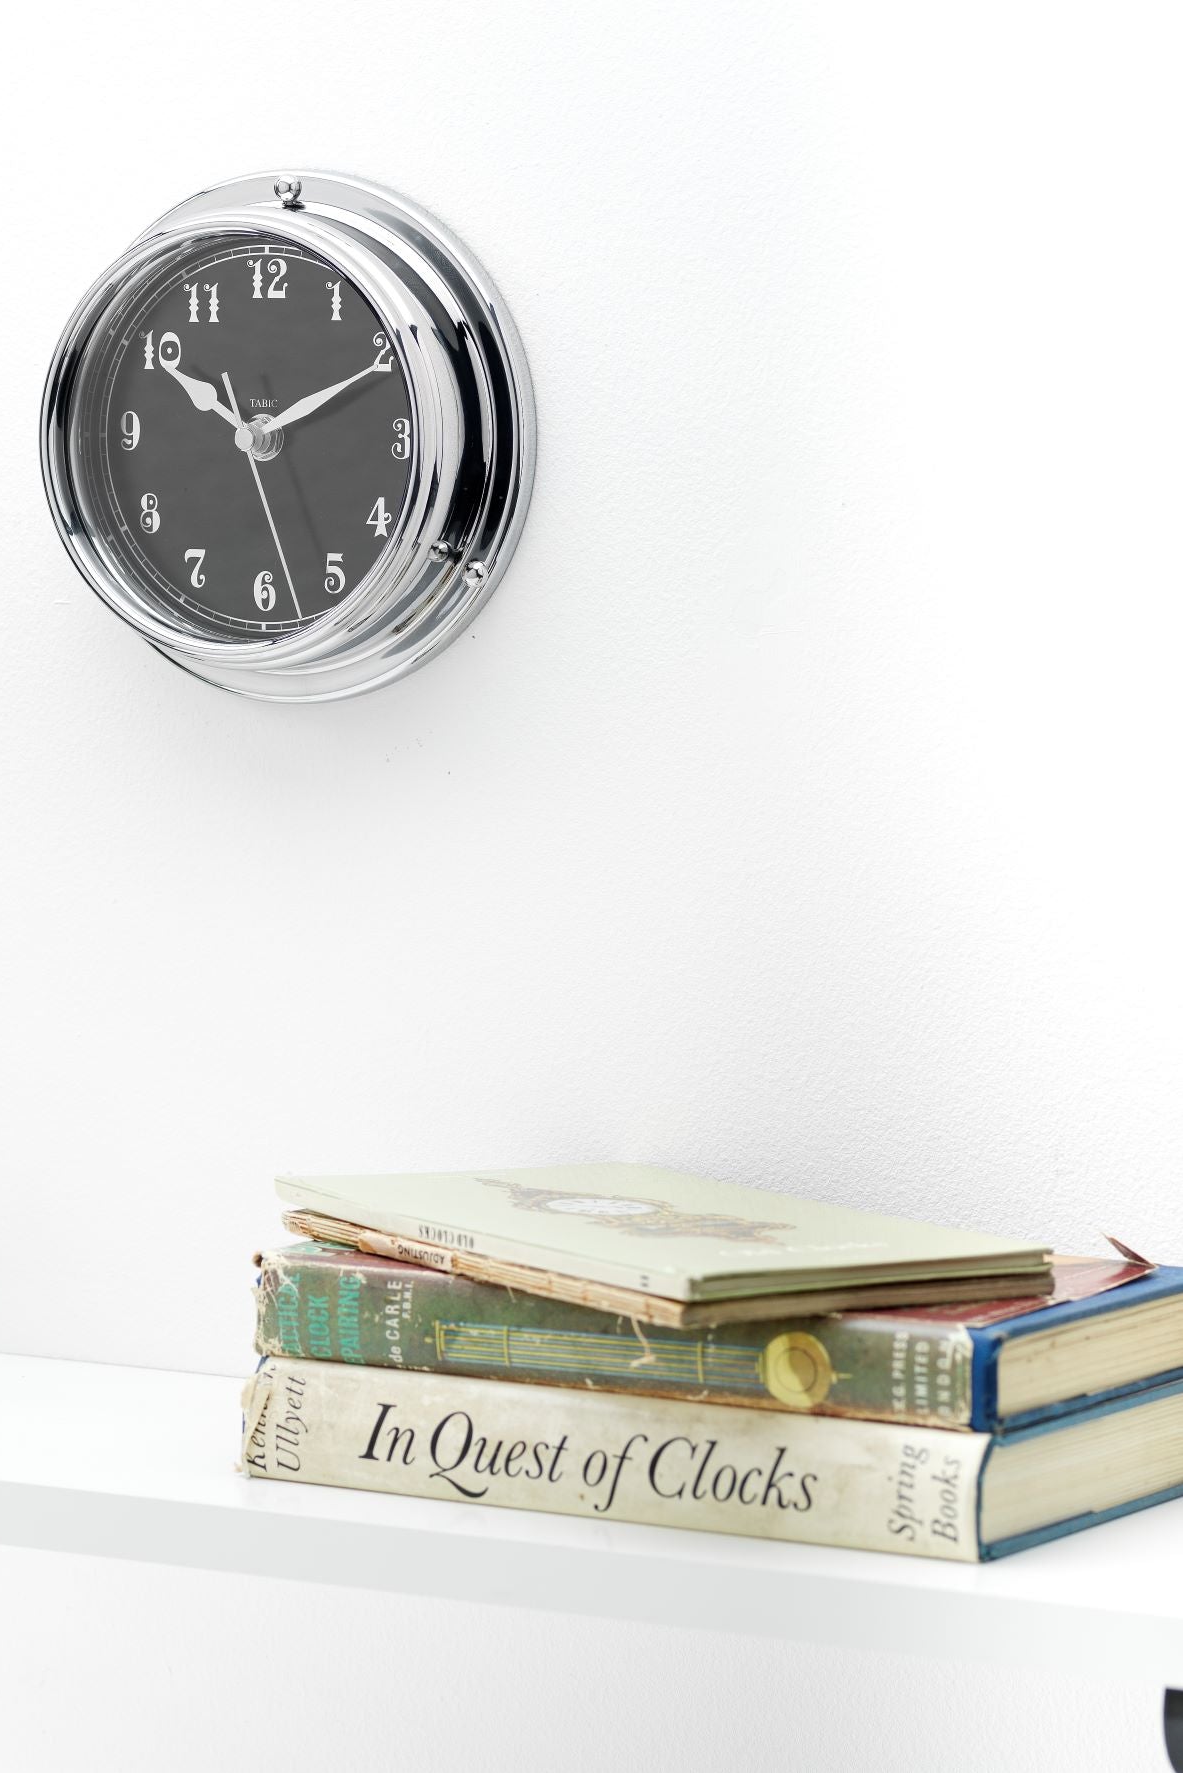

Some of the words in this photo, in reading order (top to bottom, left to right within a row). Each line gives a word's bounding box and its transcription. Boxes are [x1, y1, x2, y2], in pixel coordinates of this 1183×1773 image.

[247, 258, 288, 298] 12
[183, 282, 220, 322] 11
[325, 280, 343, 320] 1
[139, 329, 182, 370] 10
[372, 331, 395, 372] 2
[249, 398, 278, 408] TABIC
[120, 411, 141, 451] 9
[391, 418, 411, 459] 3
[140, 493, 161, 534] 8
[366, 496, 392, 536] 4
[184, 547, 206, 588] 7
[324, 552, 346, 594] 5
[253, 570, 276, 611] 6
[397, 1243, 445, 1265] ADJUSTING
[307, 1295, 332, 1358] CLOCK
[385, 1280, 402, 1341] CARLE
[388, 1346, 403, 1363] de
[275, 1376, 308, 1472] Ullyett
[357, 1402, 416, 1466] In
[429, 1411, 568, 1499] Quest
[582, 1434, 648, 1513] of
[647, 1435, 819, 1513] Clocks
[886, 1444, 930, 1542] Spring
[930, 1454, 960, 1544] Books
